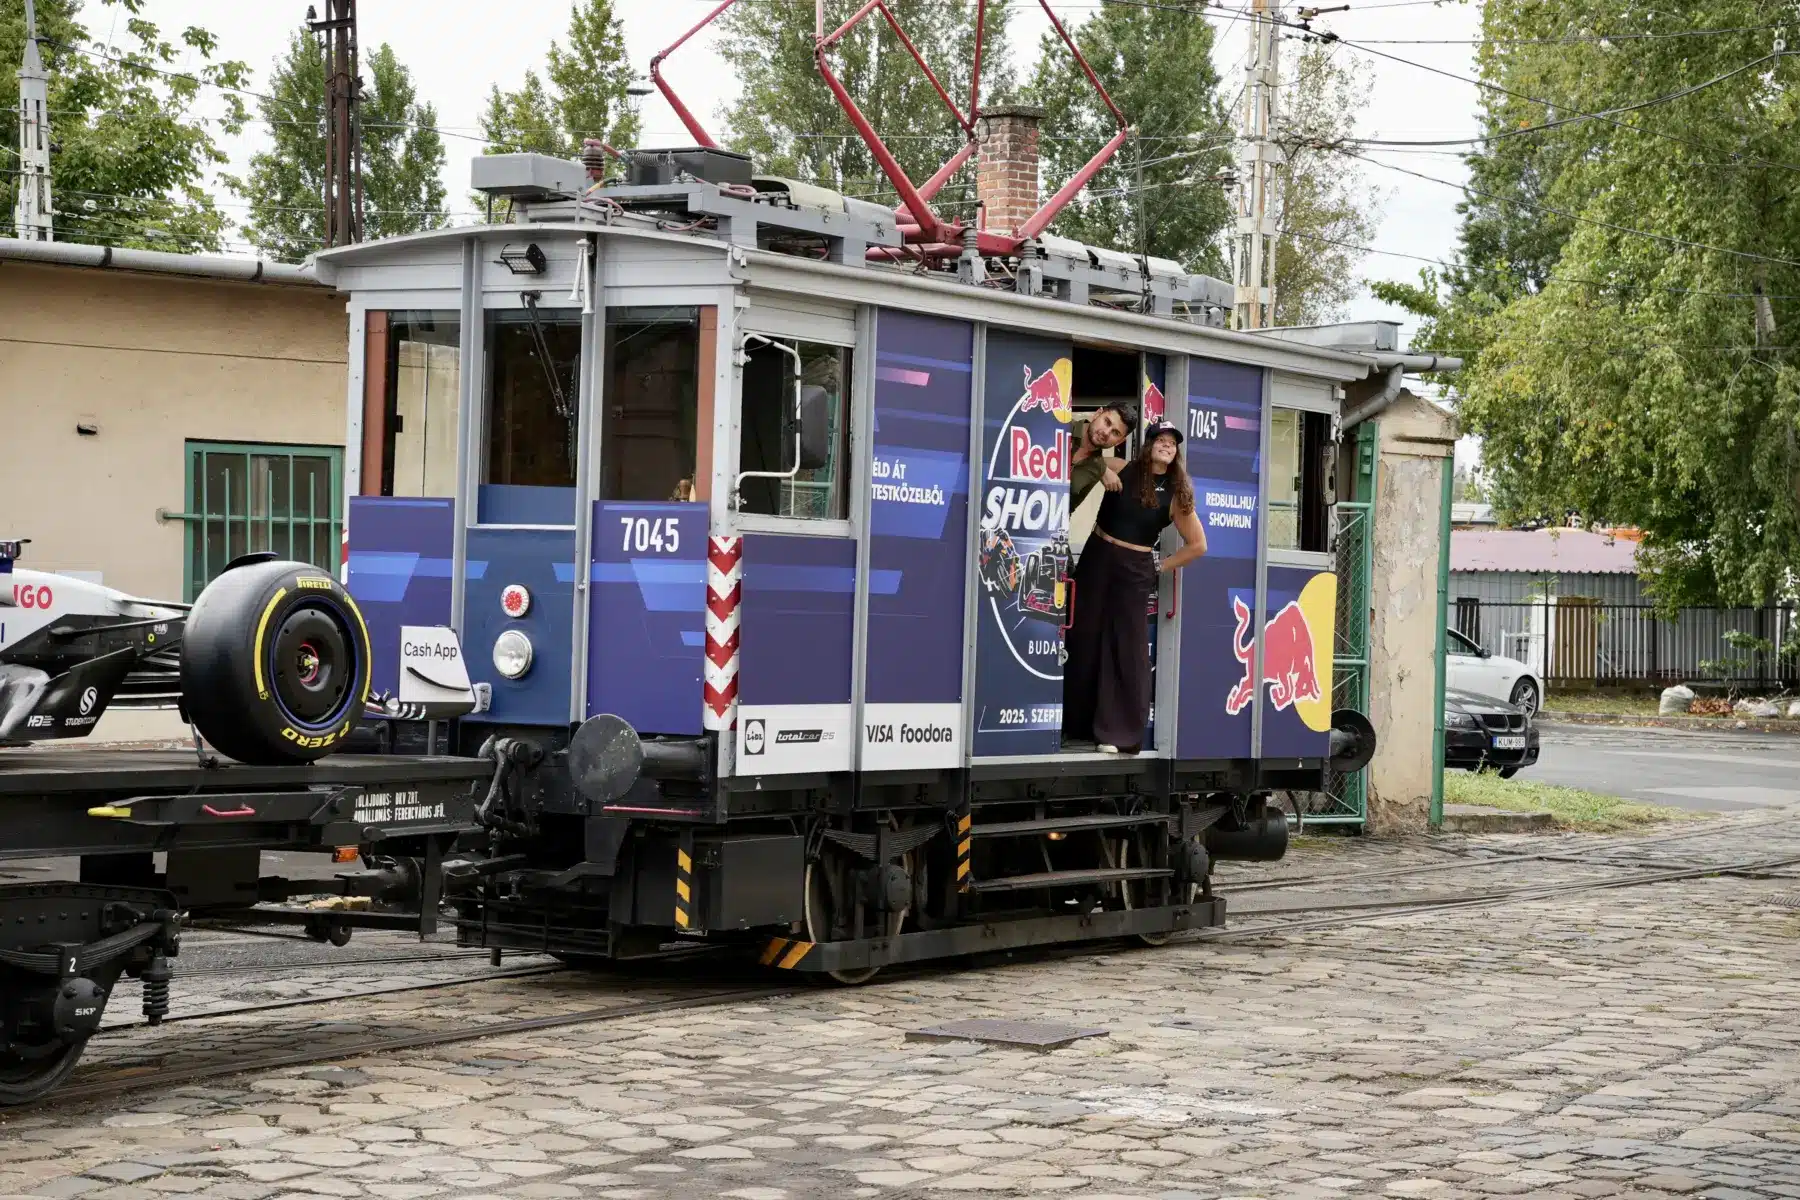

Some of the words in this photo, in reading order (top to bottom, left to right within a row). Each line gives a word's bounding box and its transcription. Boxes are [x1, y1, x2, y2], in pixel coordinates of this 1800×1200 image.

[1190, 409, 1218, 440] 7045
[1011, 426, 1064, 482] Red
[892, 459, 906, 479] ÁT
[872, 482, 944, 505] TESTKÖZELBŐL
[1209, 512, 1251, 529] SHOWRUN
[621, 517, 679, 552] 7045
[404, 642, 432, 657] Cash
[434, 642, 458, 660] App
[999, 708, 1028, 724] 2025.
[280, 727, 335, 748] ZERO
[777, 731, 820, 741] totalcar
[865, 724, 894, 743] VISA
[900, 723, 953, 743] foodora
[69, 957, 76, 973] 2
